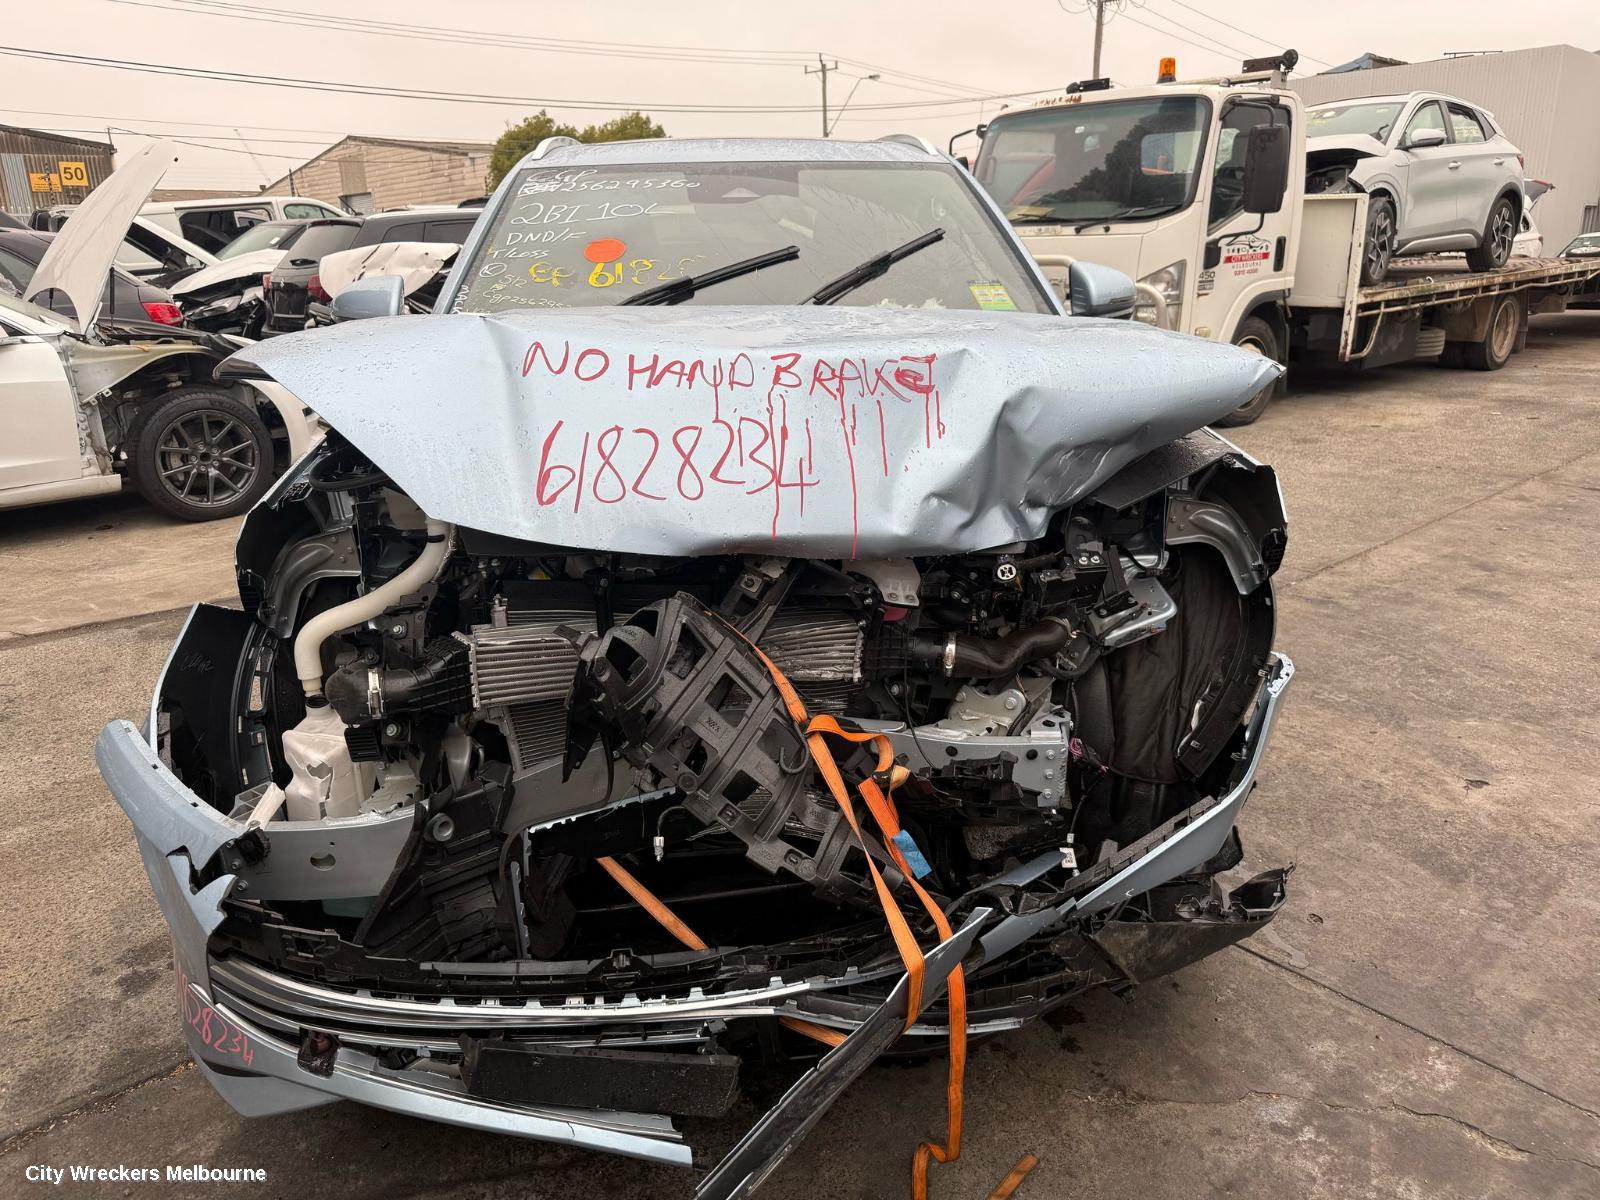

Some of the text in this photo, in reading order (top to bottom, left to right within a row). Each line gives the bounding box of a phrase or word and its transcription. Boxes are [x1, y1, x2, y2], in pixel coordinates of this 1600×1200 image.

[63, 166, 84, 181] 50
[1199, 271, 1216, 279] 450
[523, 341, 610, 382] NO
[628, 352, 755, 391] HAND
